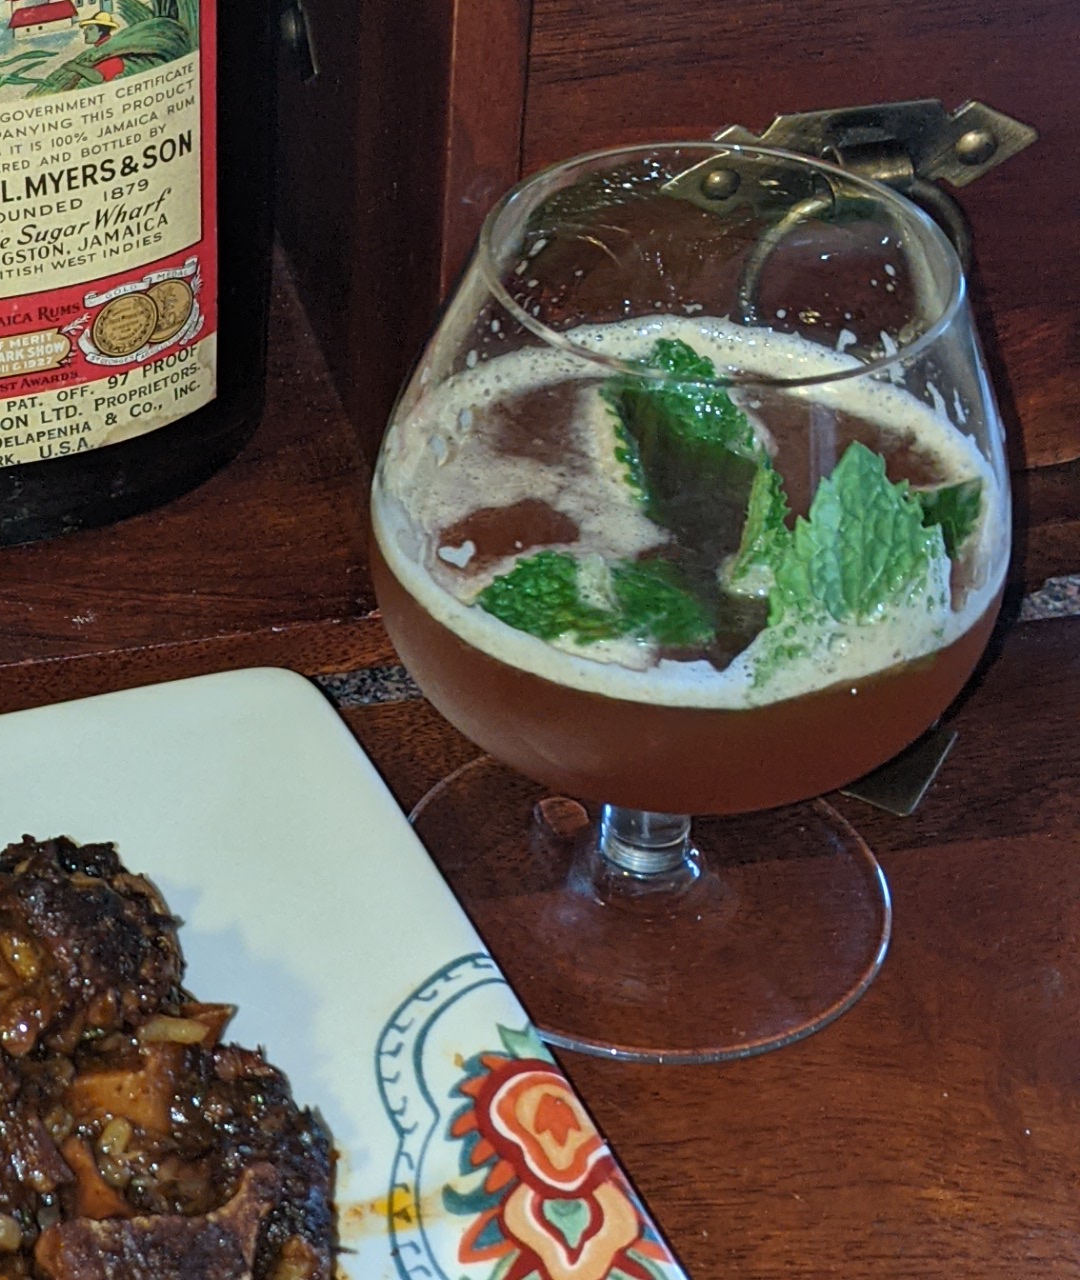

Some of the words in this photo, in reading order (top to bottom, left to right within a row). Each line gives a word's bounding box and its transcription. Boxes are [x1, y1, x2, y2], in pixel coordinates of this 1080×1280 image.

[0, 94, 105, 122] GOVERNMENT
[115, 62, 194, 99] CERTIFICATE
[80, 108, 113, 124] THIS
[122, 79, 195, 114] PRODUCT
[10, 144, 21, 155] IT
[31, 140, 42, 152] IS
[51, 132, 88, 148] 100%
[96, 111, 158, 138] JAMAICA
[167, 95, 195, 115] RUM
[40, 152, 72, 167] AND
[81, 132, 142, 158] BOTTLED
[150, 123, 167, 137] BY
[104, 178, 150, 202] 1879
[17, 221, 90, 247] Sugar
[94, 187, 172, 231] Wharf
[78, 212, 168, 251] JAMAICA
[51, 253, 96, 270] WEST
[102, 232, 163, 258] INDIES
[105, 284, 137, 299] GOLD
[38, 302, 81, 322] RUMS
[10, 333, 53, 348] MERIT
[27, 341, 66, 358] SHOW
[23, 356, 53, 370] 1927
[7, 396, 43, 412] PAT.
[57, 385, 95, 402] OFF.
[108, 372, 129, 389] 97
[142, 345, 199, 378] PROOF
[20, 371, 79, 389] AWARDS
[41, 404, 83, 424] LTD.
[105, 412, 118, 426] &
[39, 436, 95, 460] U.S.A.
